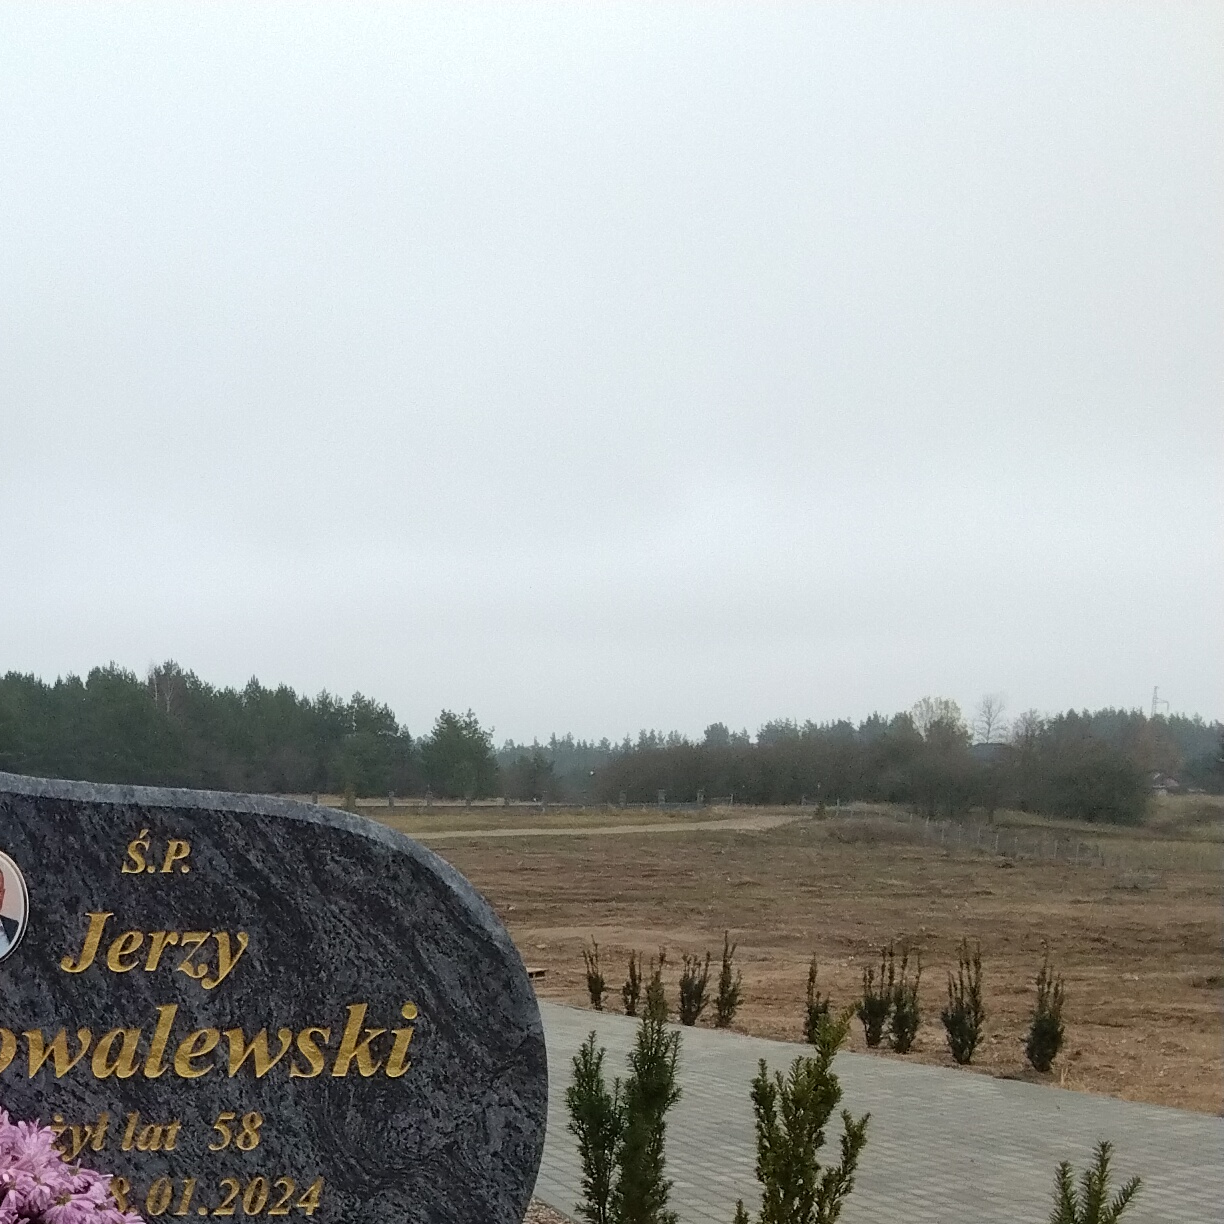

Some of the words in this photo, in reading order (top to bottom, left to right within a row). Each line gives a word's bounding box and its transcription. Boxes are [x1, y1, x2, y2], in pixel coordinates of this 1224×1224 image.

[121, 829, 192, 874] Ś.P.
[60, 911, 249, 990] Jerzy
[121, 1110, 182, 1151] lat
[208, 1111, 264, 1151] 58
[109, 1176, 324, 1216] 8.01.2024
